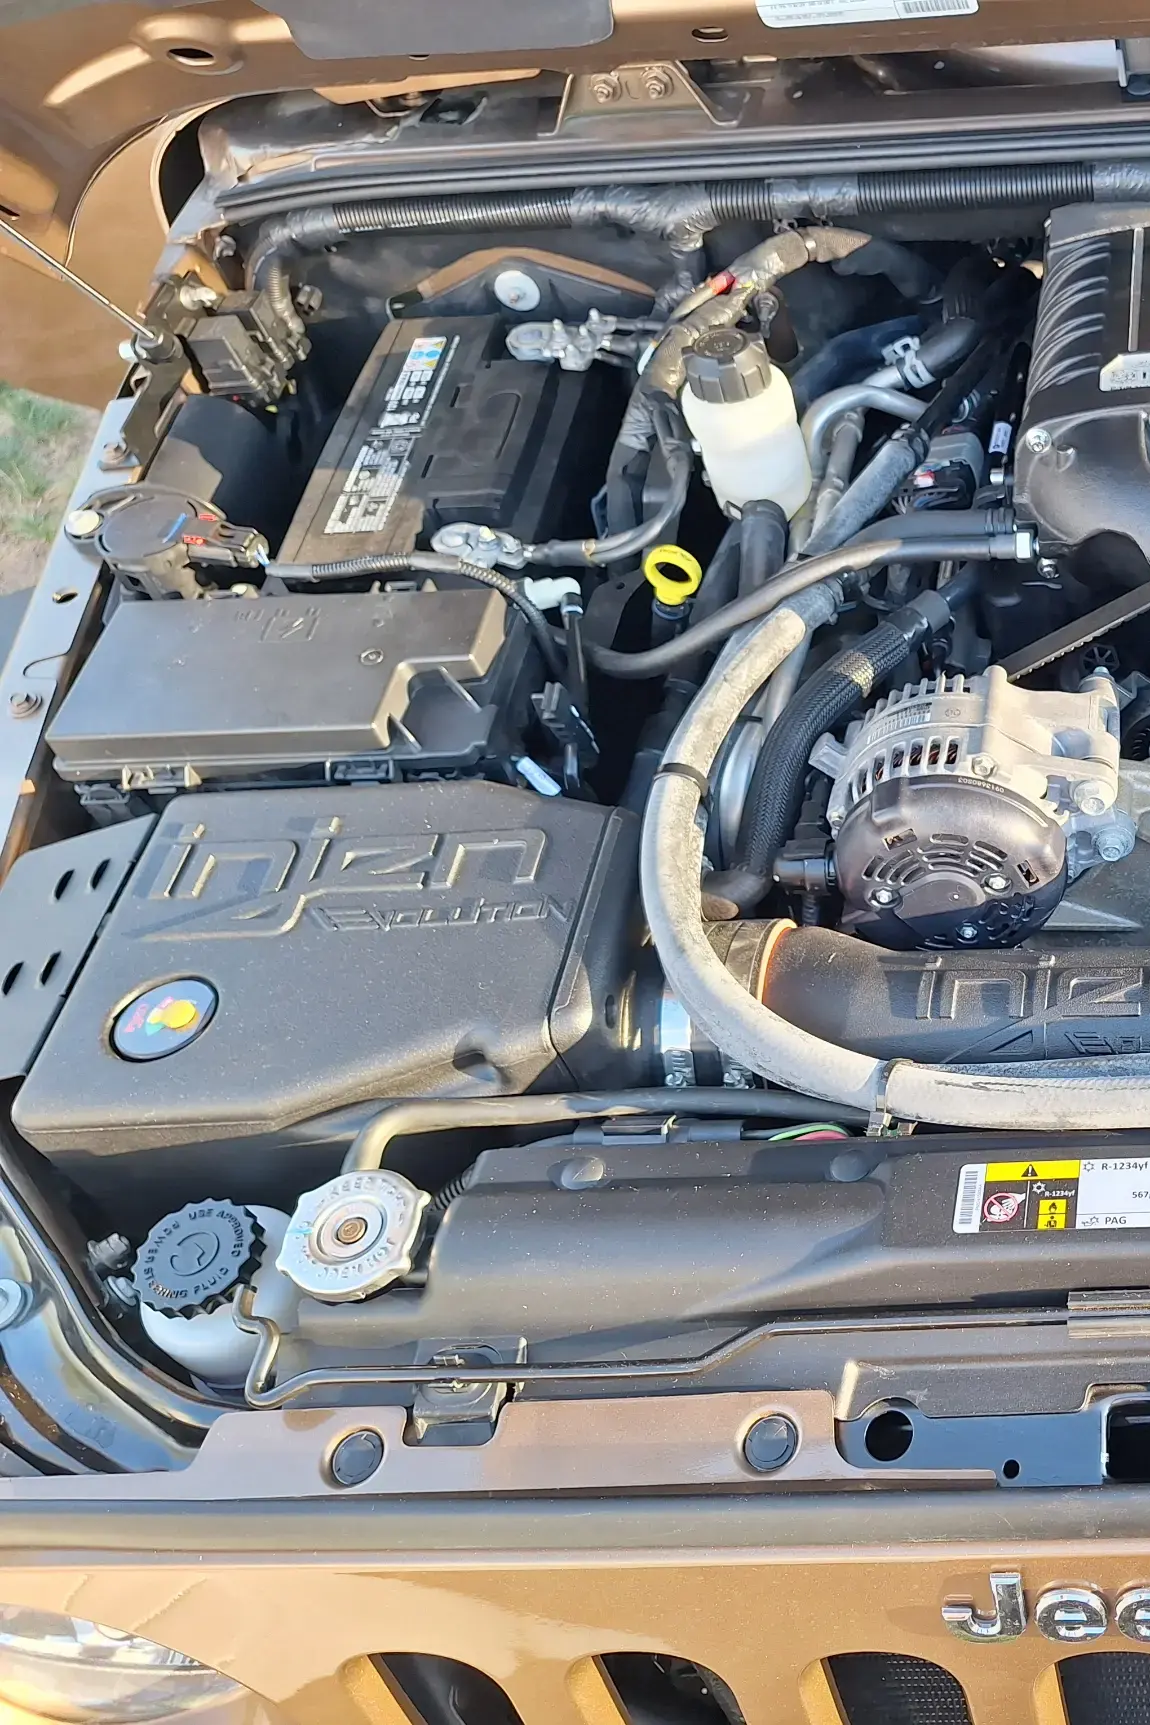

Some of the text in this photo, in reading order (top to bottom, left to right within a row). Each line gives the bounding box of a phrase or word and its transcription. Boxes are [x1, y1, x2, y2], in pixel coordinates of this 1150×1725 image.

[1101, 1161, 1149, 1171] R-1234yf
[1044, 1189, 1076, 1198] R-1234yf
[1104, 1216, 1127, 1225] PAG
[188, 1208, 245, 1258] USE APPROVED
[144, 1220, 181, 1264] POWER
[193, 1266, 230, 1296] FLUID
